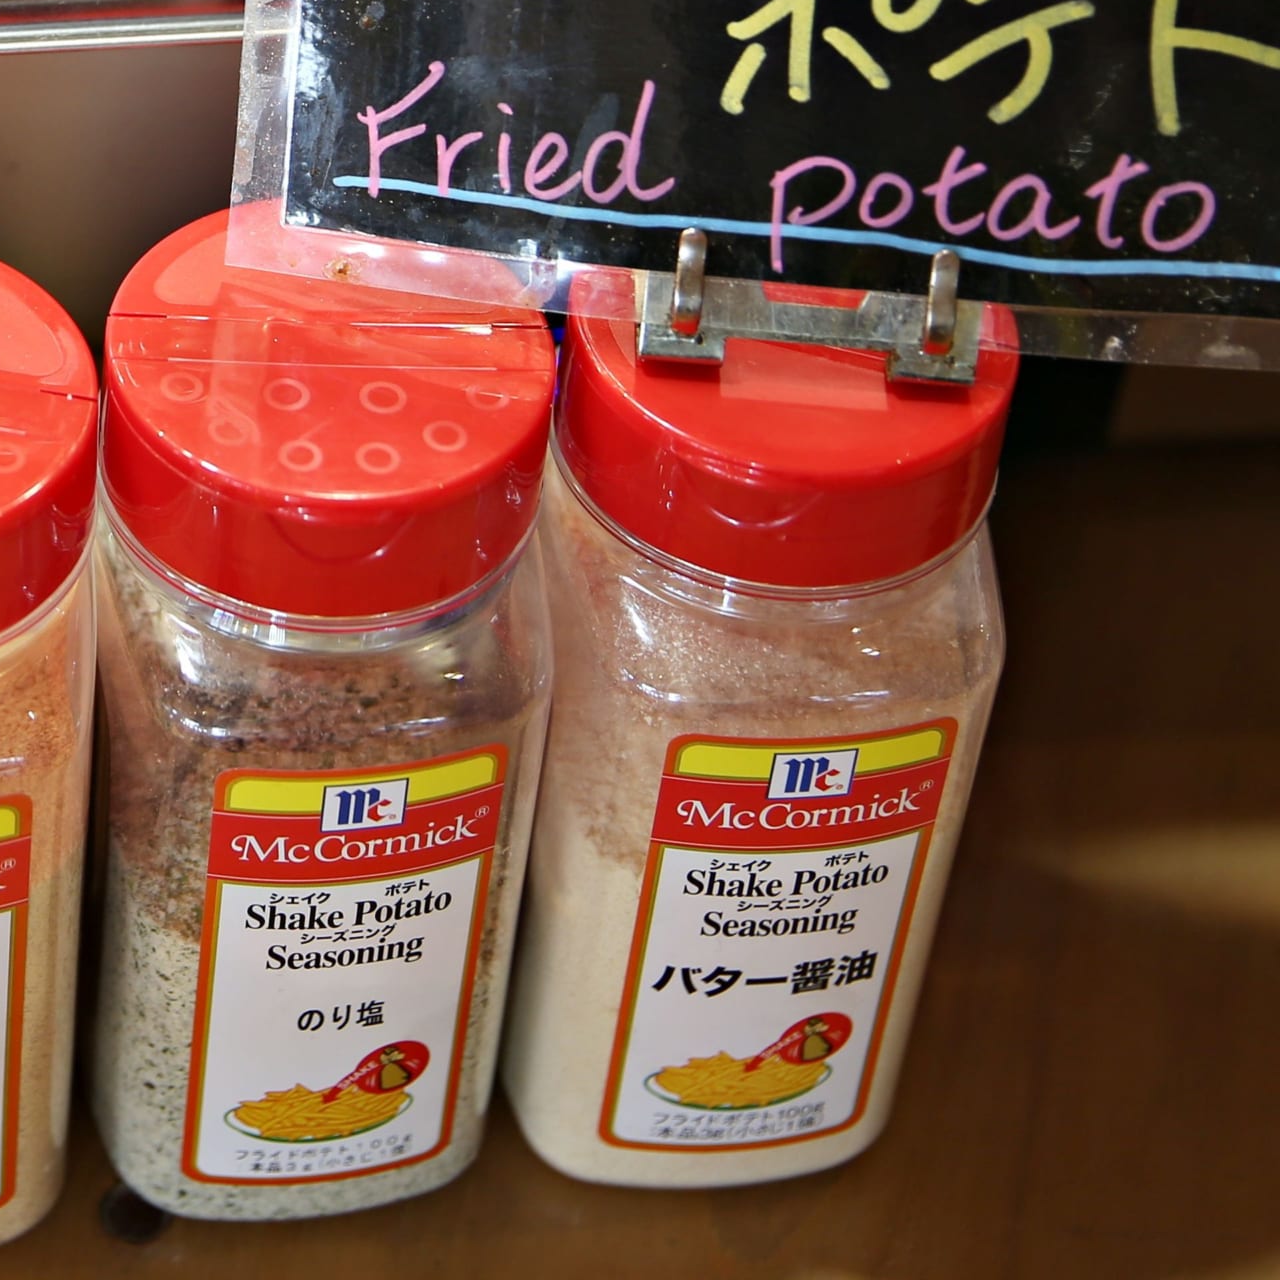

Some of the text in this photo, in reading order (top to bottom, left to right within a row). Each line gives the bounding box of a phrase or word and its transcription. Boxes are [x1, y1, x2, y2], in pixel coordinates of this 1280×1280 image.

[357, 61, 1217, 272] Fried potato
[676, 787, 920, 830] McCormick
[231, 814, 478, 863] McCormick
[710, 851, 869, 871] シェイク ポテト
[269, 879, 430, 905] シェイク ポテト
[683, 863, 889, 897] Shake Potato
[245, 890, 452, 931] Shake Potato
[737, 895, 834, 912] シーズニング
[300, 924, 398, 945] シーズニング
[700, 907, 859, 937] Seasoning
[265, 936, 425, 971] Seasoning
[652, 950, 878, 997] バター醤油
[297, 1000, 385, 1031] のり塩
